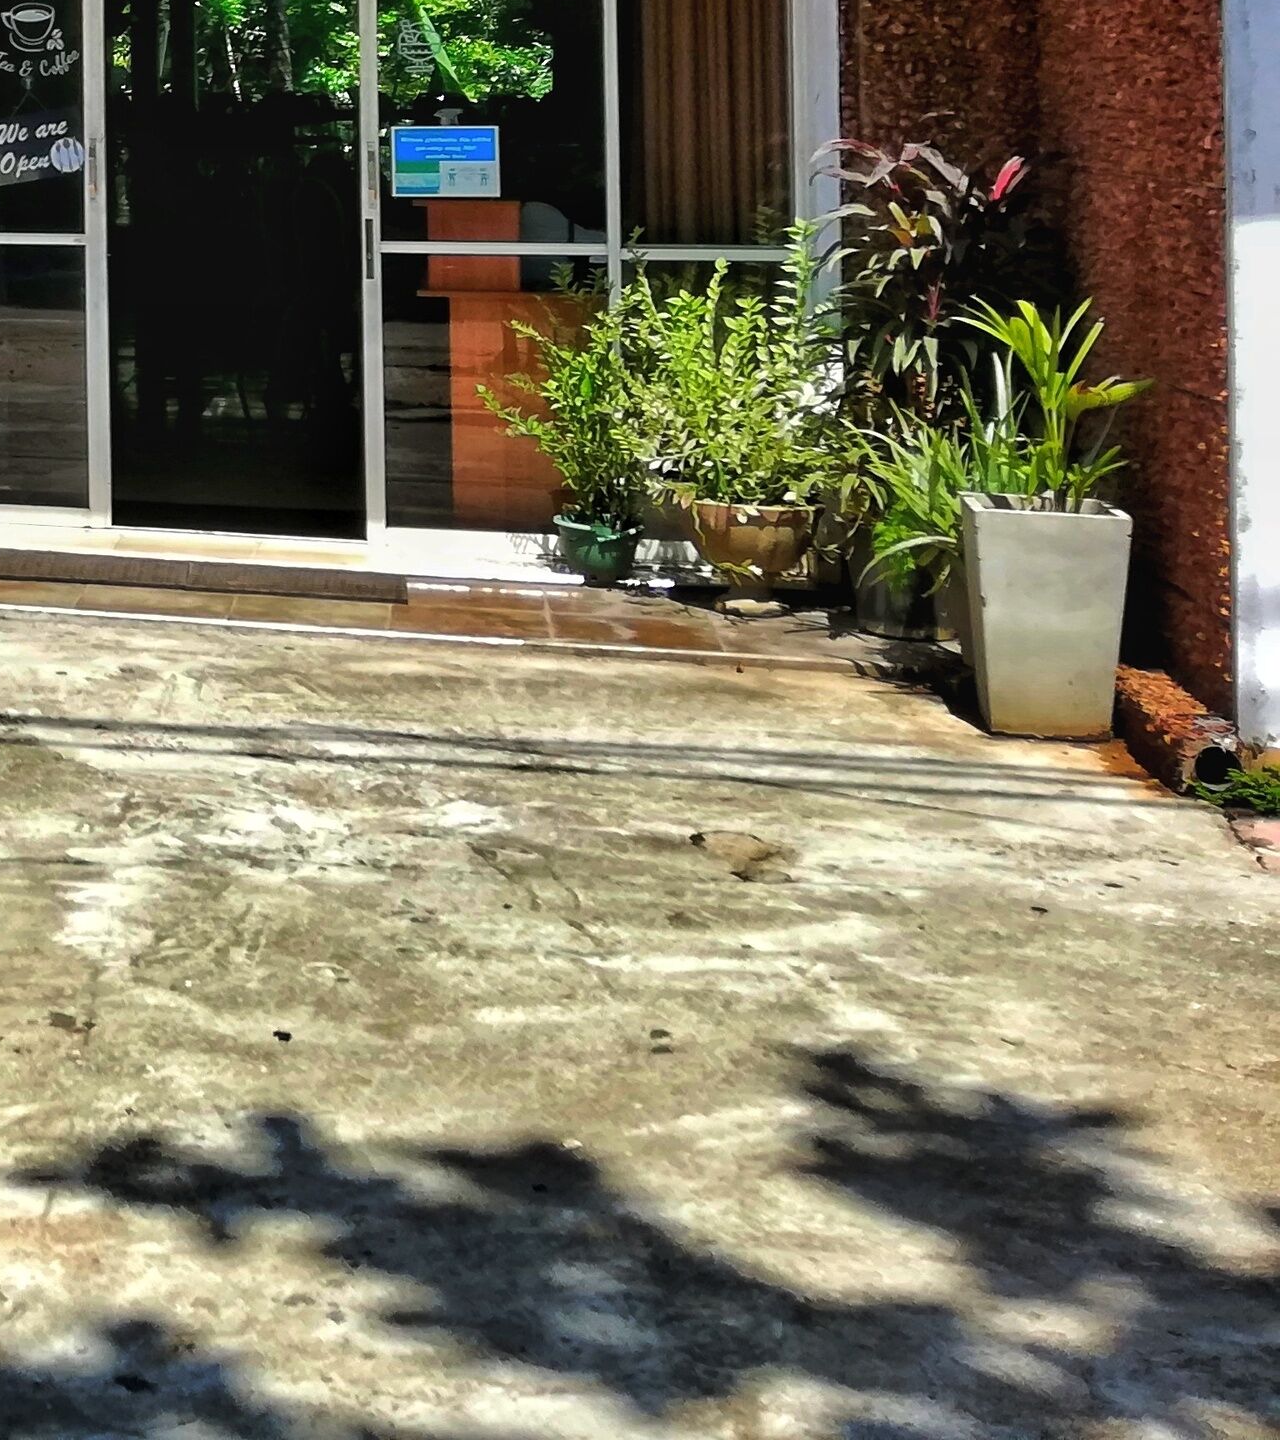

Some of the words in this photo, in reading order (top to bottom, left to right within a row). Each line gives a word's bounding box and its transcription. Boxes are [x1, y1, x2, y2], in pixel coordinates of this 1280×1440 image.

[19, 60, 33, 77] &
[40, 50, 80, 77] Coffee
[35, 120, 68, 138] are
[0, 151, 50, 178] Open
